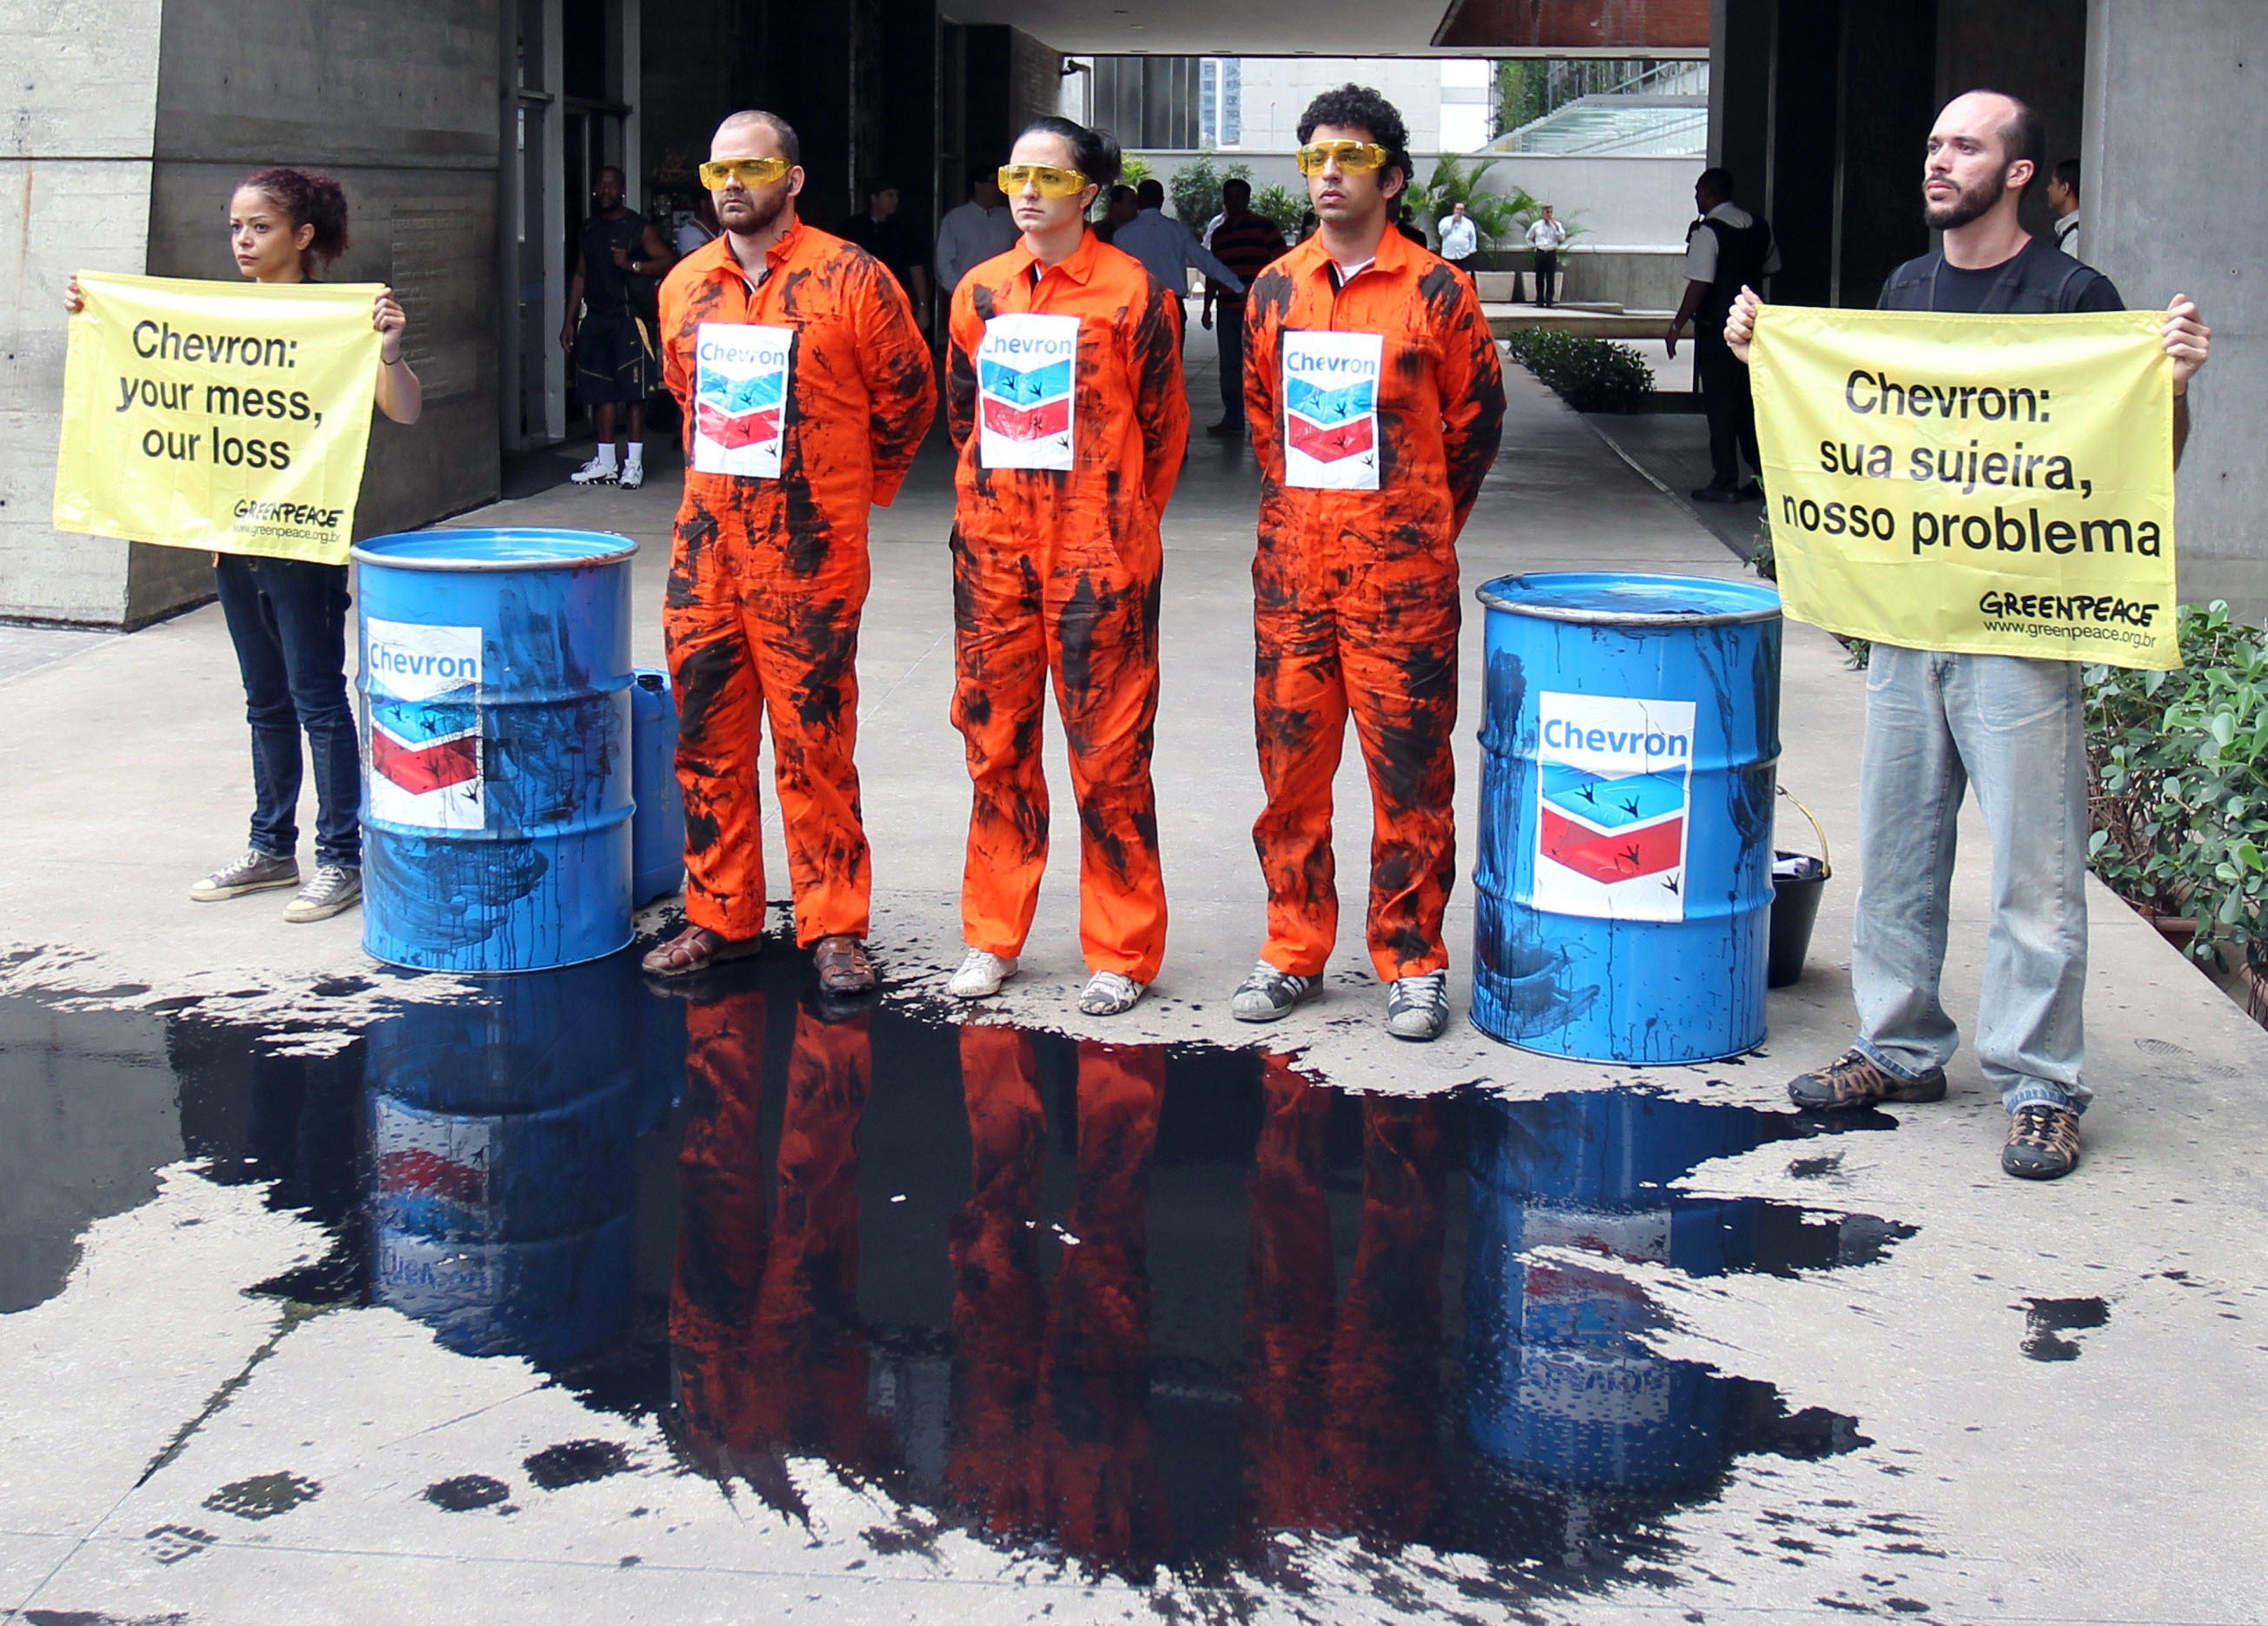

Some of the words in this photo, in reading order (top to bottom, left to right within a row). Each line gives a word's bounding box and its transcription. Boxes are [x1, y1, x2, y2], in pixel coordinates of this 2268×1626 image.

[133, 320, 297, 367] Chevron:
[1287, 352, 1375, 374] Chevron
[117, 376, 193, 412] your
[206, 384, 322, 428] mess,
[1846, 370, 2049, 423] Chevron:
[143, 429, 200, 462] our
[213, 426, 290, 469] loss
[1820, 439, 1892, 478] sua
[1910, 439, 2092, 498] sujeira,
[234, 499, 344, 527] GREENPEACE
[1783, 493, 1894, 540] nosso
[1913, 506, 2161, 557] problema
[1980, 591, 2159, 626] GREENPEACE
[1984, 620, 2156, 648] www.greenpeace.org.br
[371, 643, 476, 678] Chevron
[1544, 719, 1688, 757] Chevron
